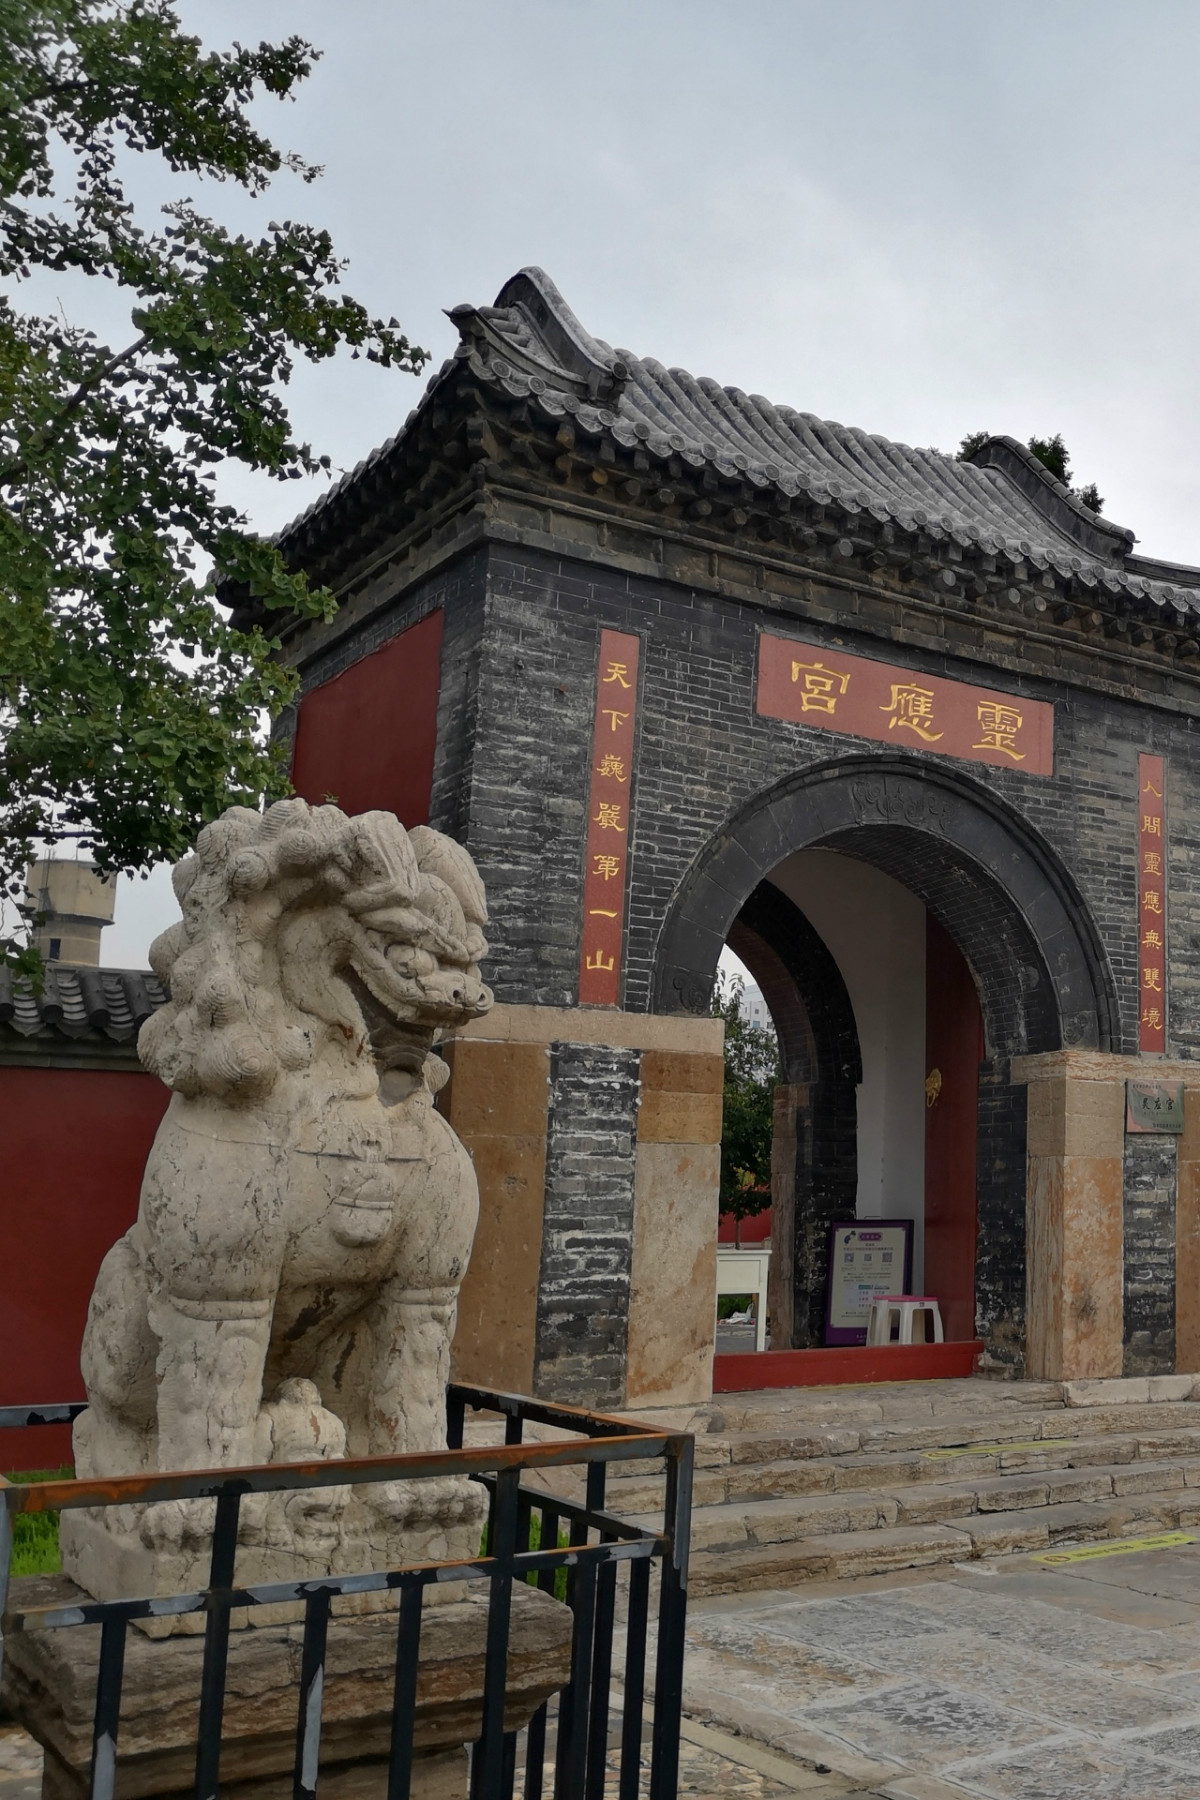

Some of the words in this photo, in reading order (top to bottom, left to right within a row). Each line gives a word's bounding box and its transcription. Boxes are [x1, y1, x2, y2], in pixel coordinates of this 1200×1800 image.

[1141, 780, 1163, 1031] 人間靈應無雙境
